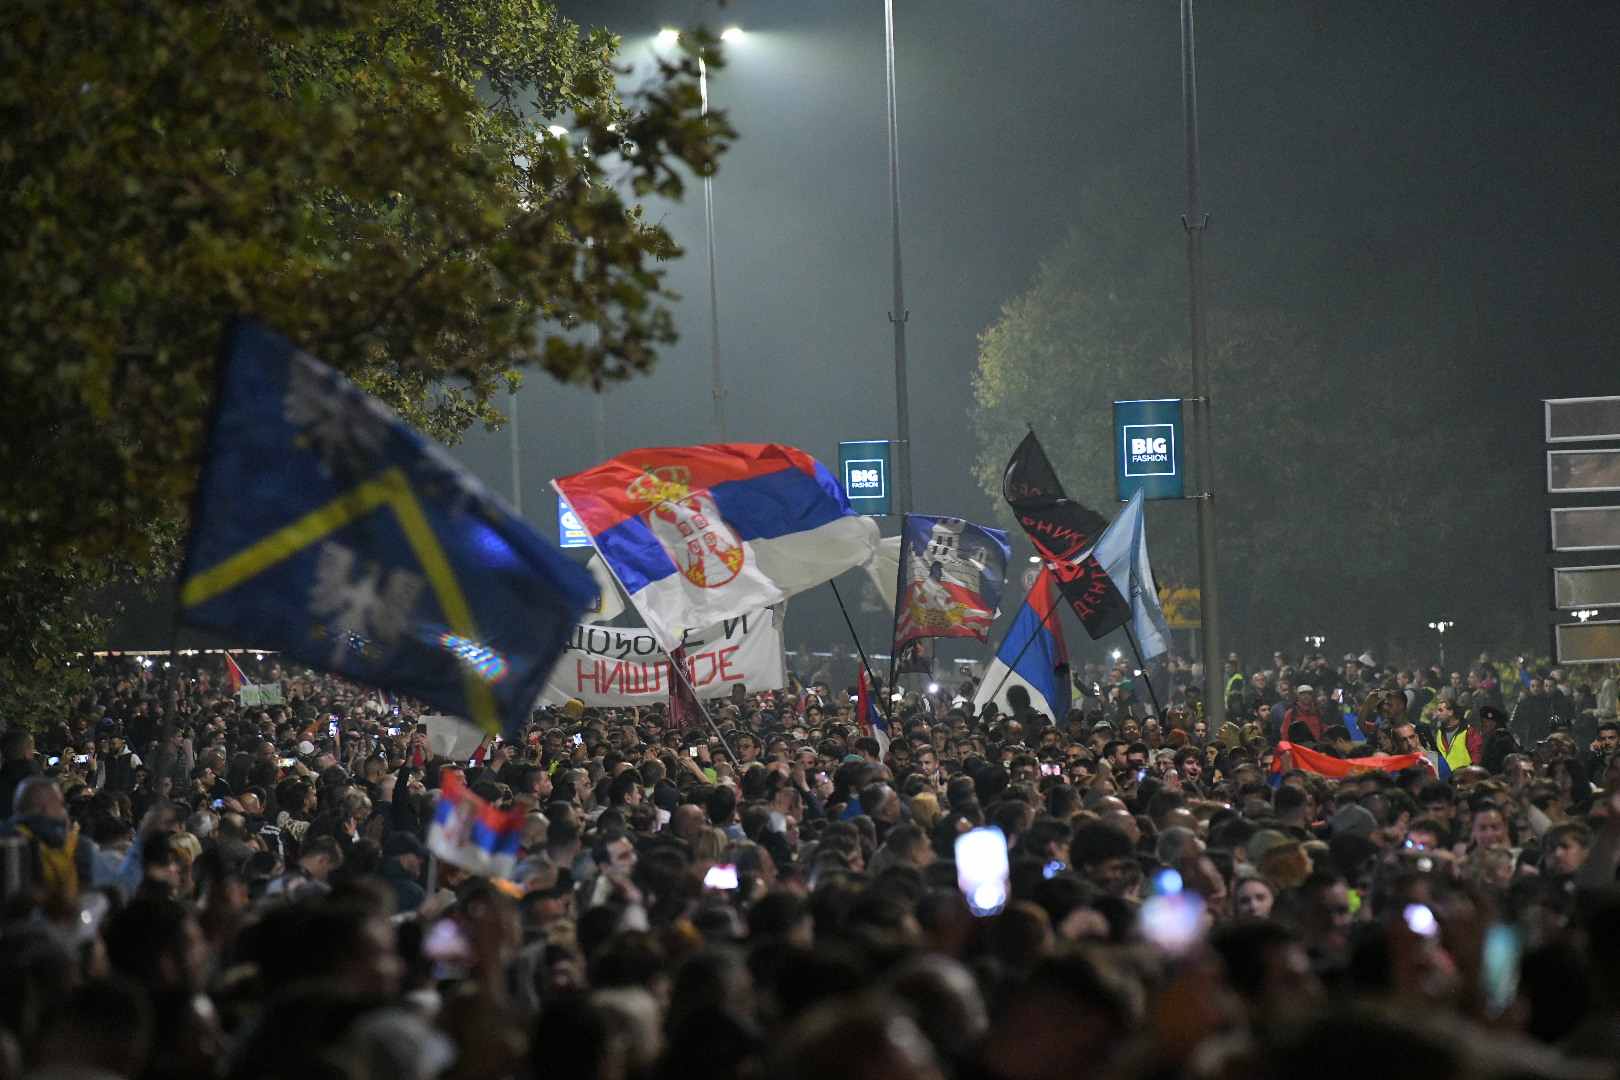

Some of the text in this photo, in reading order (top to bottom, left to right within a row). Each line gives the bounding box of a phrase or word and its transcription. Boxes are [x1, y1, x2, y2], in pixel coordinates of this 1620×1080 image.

[1131, 437, 1167, 455] BIG
[1131, 454, 1168, 463] FASHION
[851, 469, 879, 482] BIG
